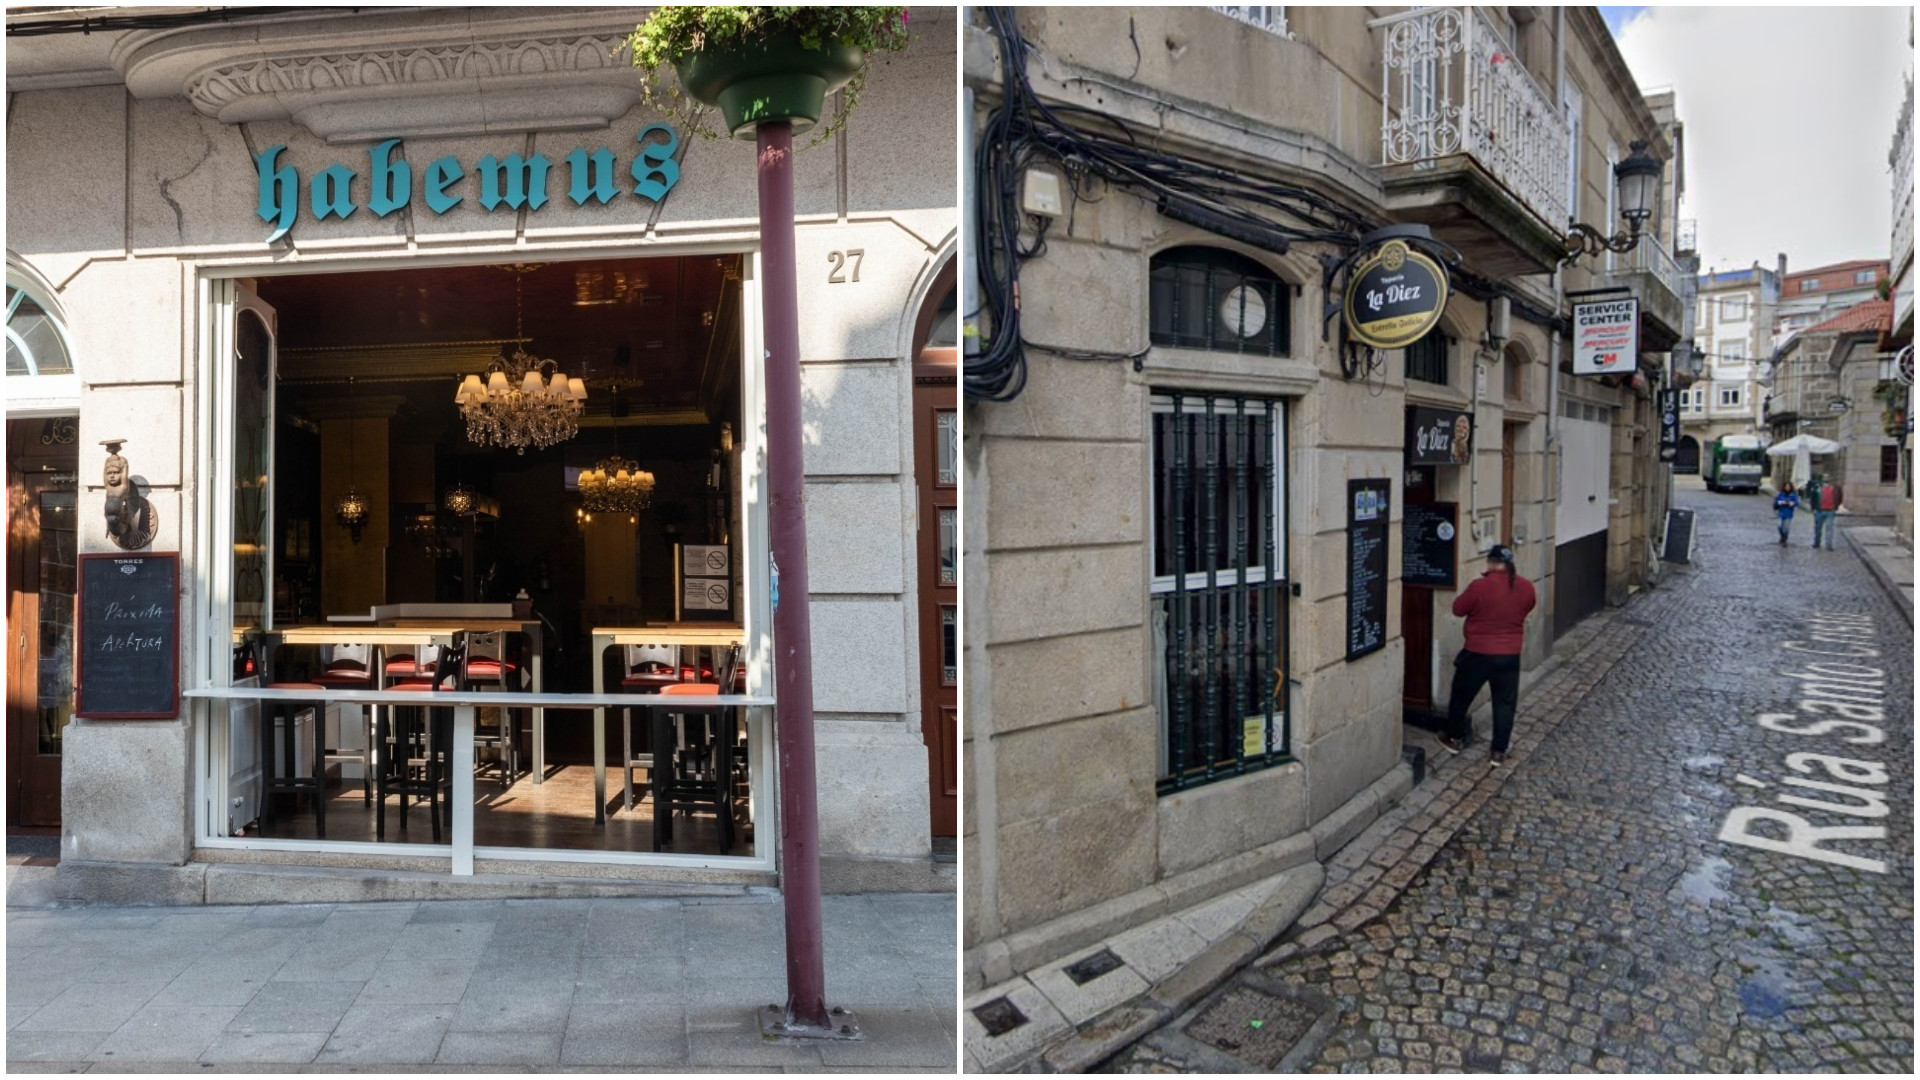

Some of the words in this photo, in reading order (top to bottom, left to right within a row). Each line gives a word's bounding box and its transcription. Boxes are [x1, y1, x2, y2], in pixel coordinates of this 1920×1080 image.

[254, 122, 681, 245] habemus
[827, 248, 865, 284] 27
[1366, 289, 1384, 312] La
[1386, 284, 1420, 304] Diez
[1578, 302, 1633, 317] SERVICE
[1579, 313, 1632, 326] CENTER
[1583, 325, 1630, 335] MERCURY
[1583, 338, 1630, 347] MERCURY
[1593, 353, 1618, 366] CM
[1417, 426, 1428, 457] La
[1429, 426, 1449, 451] Diez
[100, 632, 163, 652] APERTURA
